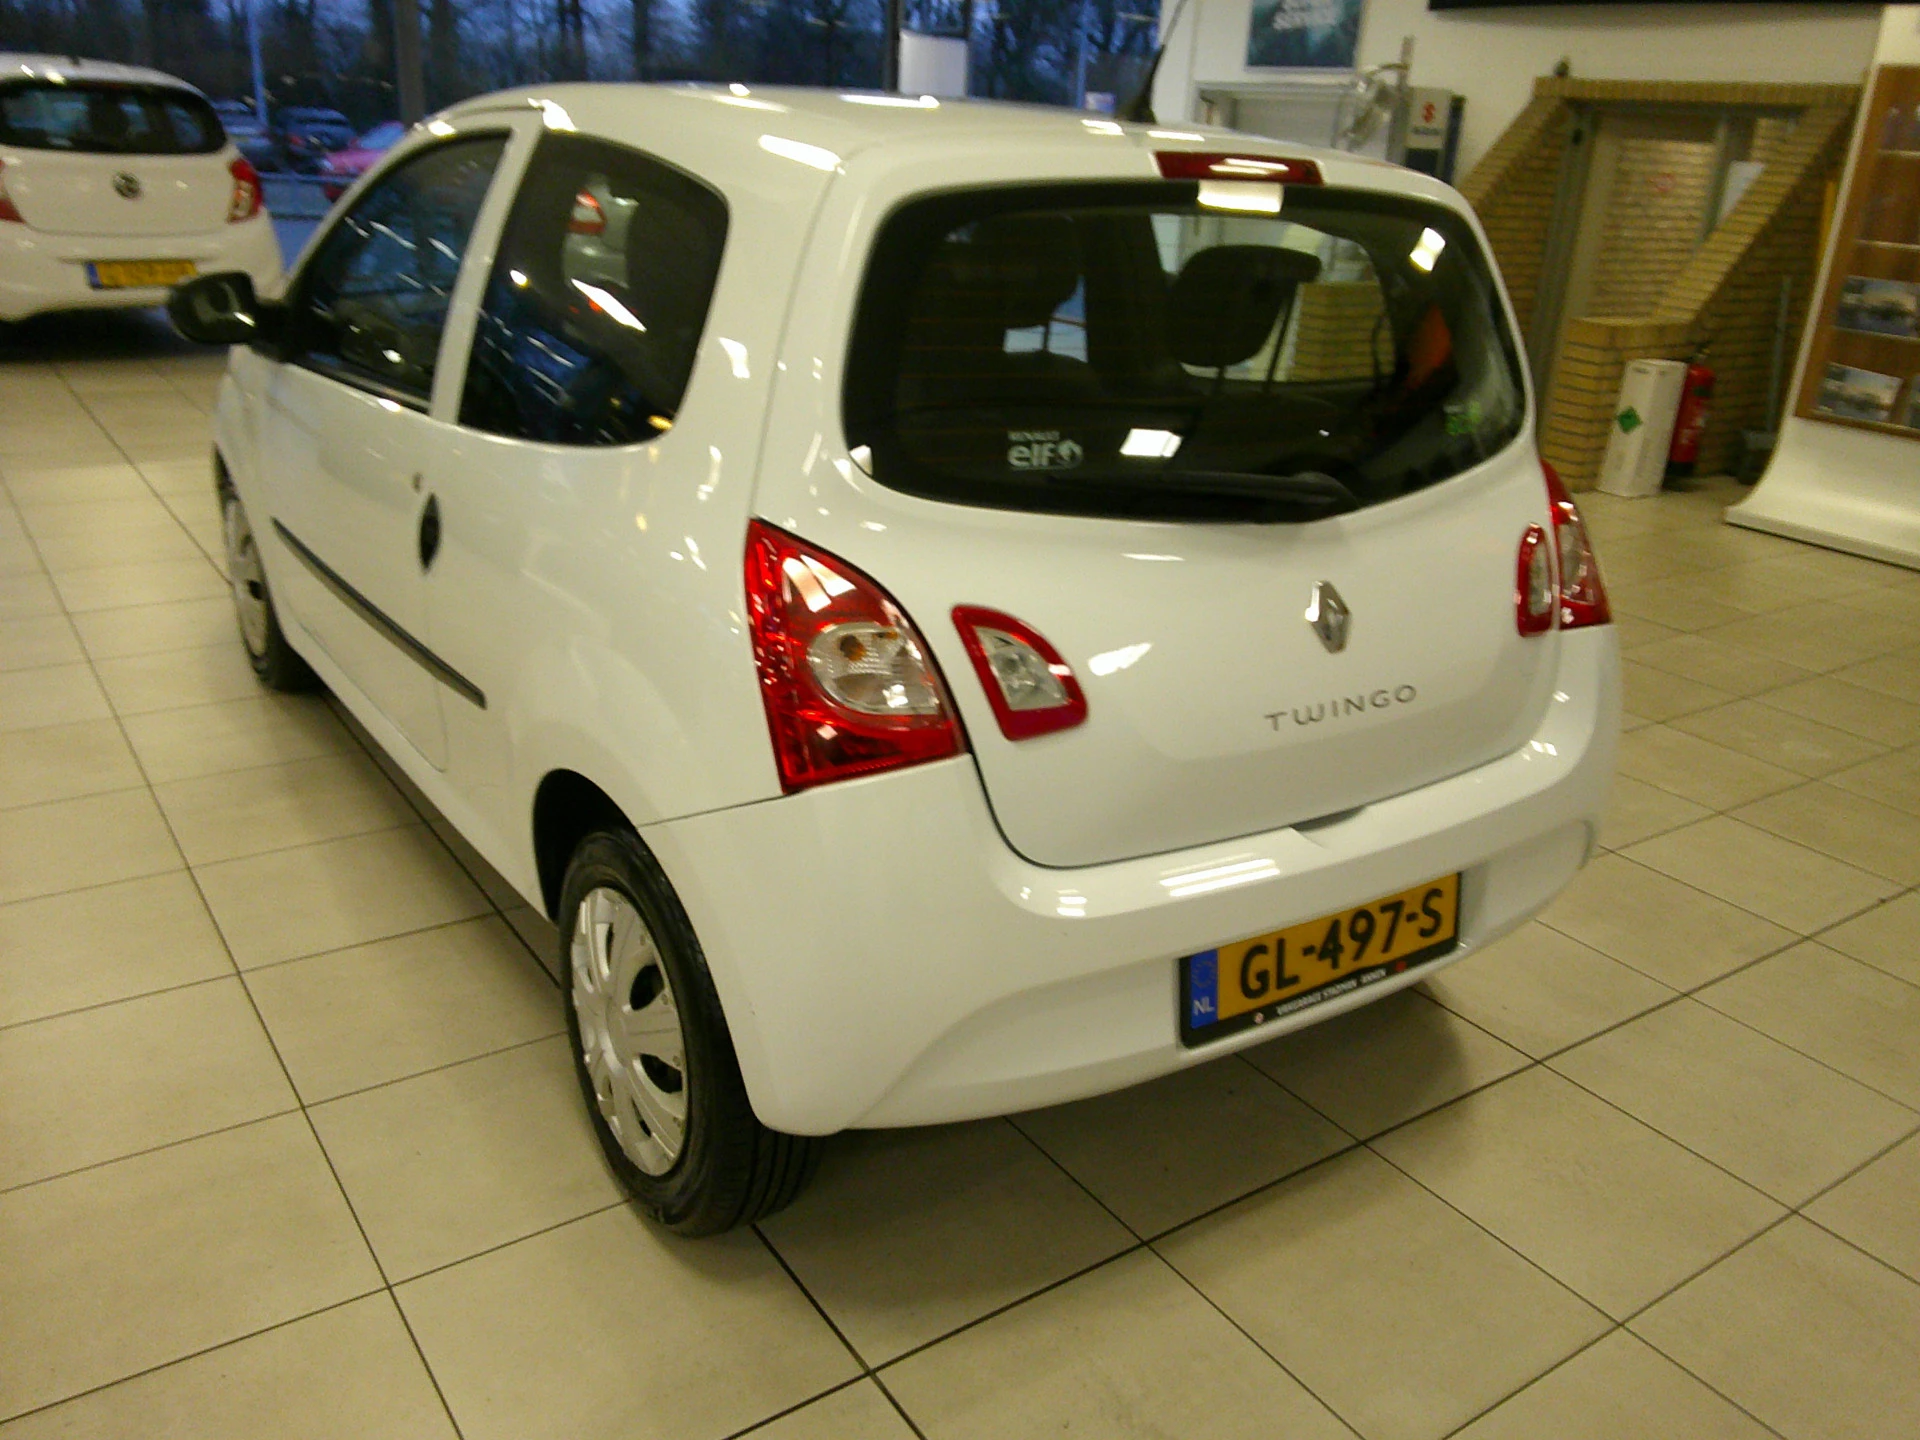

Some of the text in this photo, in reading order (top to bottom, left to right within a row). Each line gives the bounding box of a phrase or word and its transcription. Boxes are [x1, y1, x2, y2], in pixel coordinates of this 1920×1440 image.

[1264, 684, 1417, 731] TWINGO
[1240, 888, 1443, 1000] GL-497-S
[1193, 997, 1215, 1016] NL
